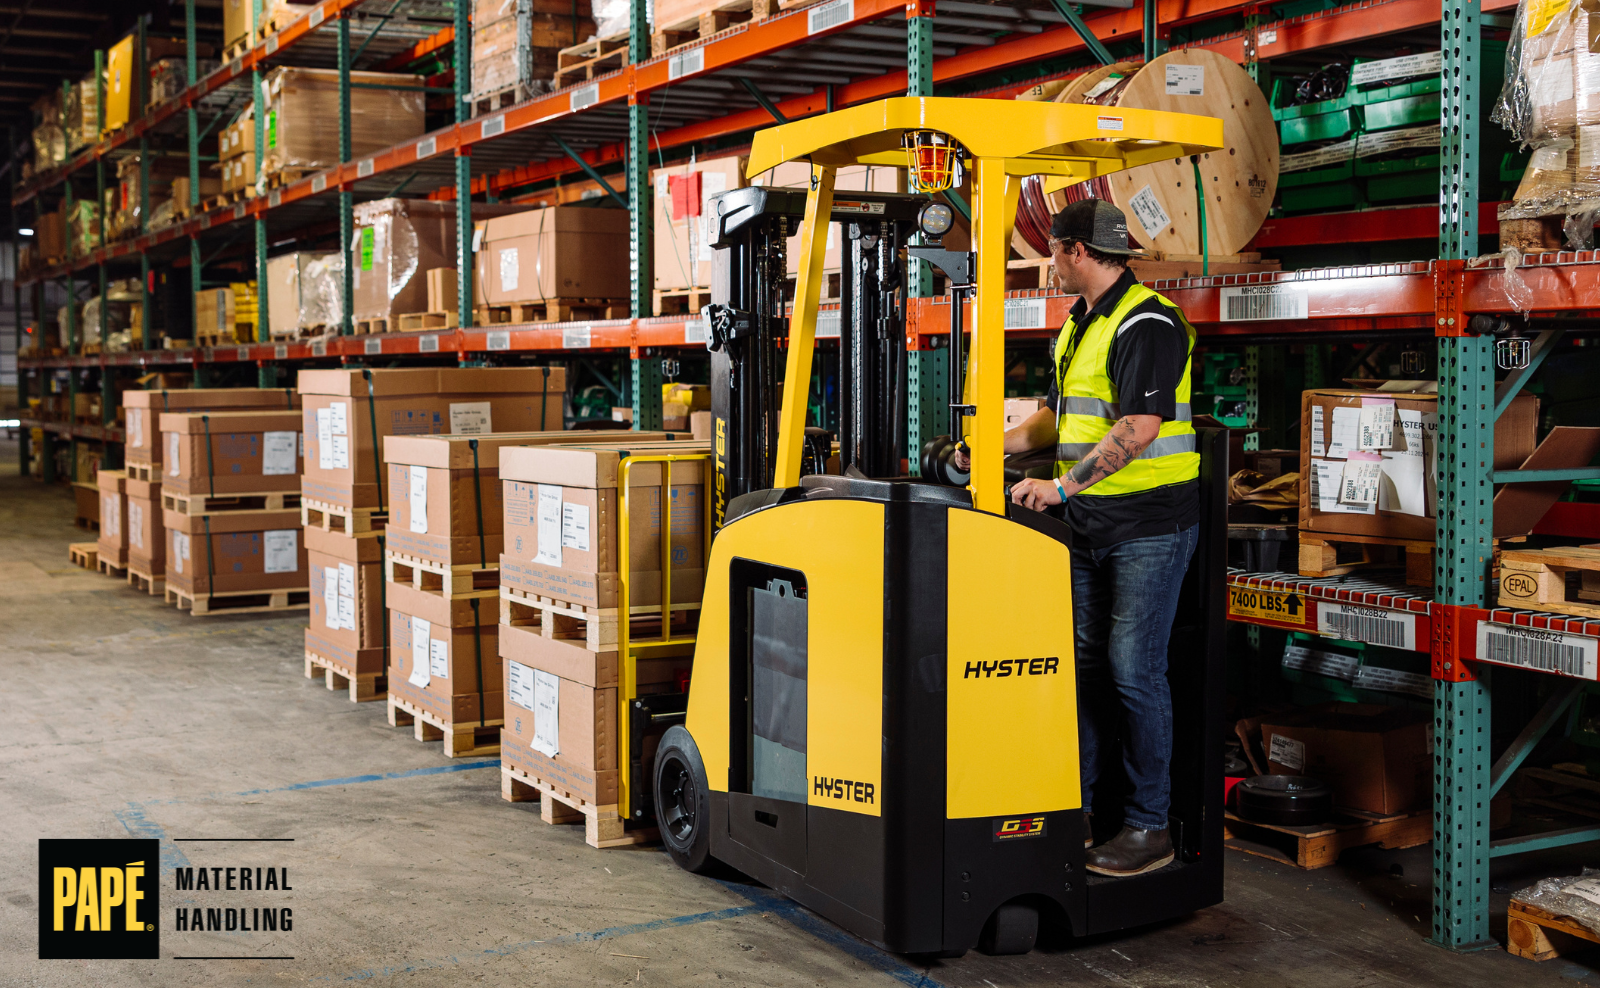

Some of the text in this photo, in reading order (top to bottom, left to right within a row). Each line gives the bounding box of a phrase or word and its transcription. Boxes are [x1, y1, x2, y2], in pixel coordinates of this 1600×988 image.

[1393, 419, 1425, 430] HYSTER
[715, 417, 726, 529] HYSTER
[1509, 578, 1533, 593] EPAL
[1231, 591, 1257, 609] 7400
[1260, 595, 1286, 613] LBS.
[963, 656, 1060, 679] HYSTER
[813, 775, 875, 805] HYSTER
